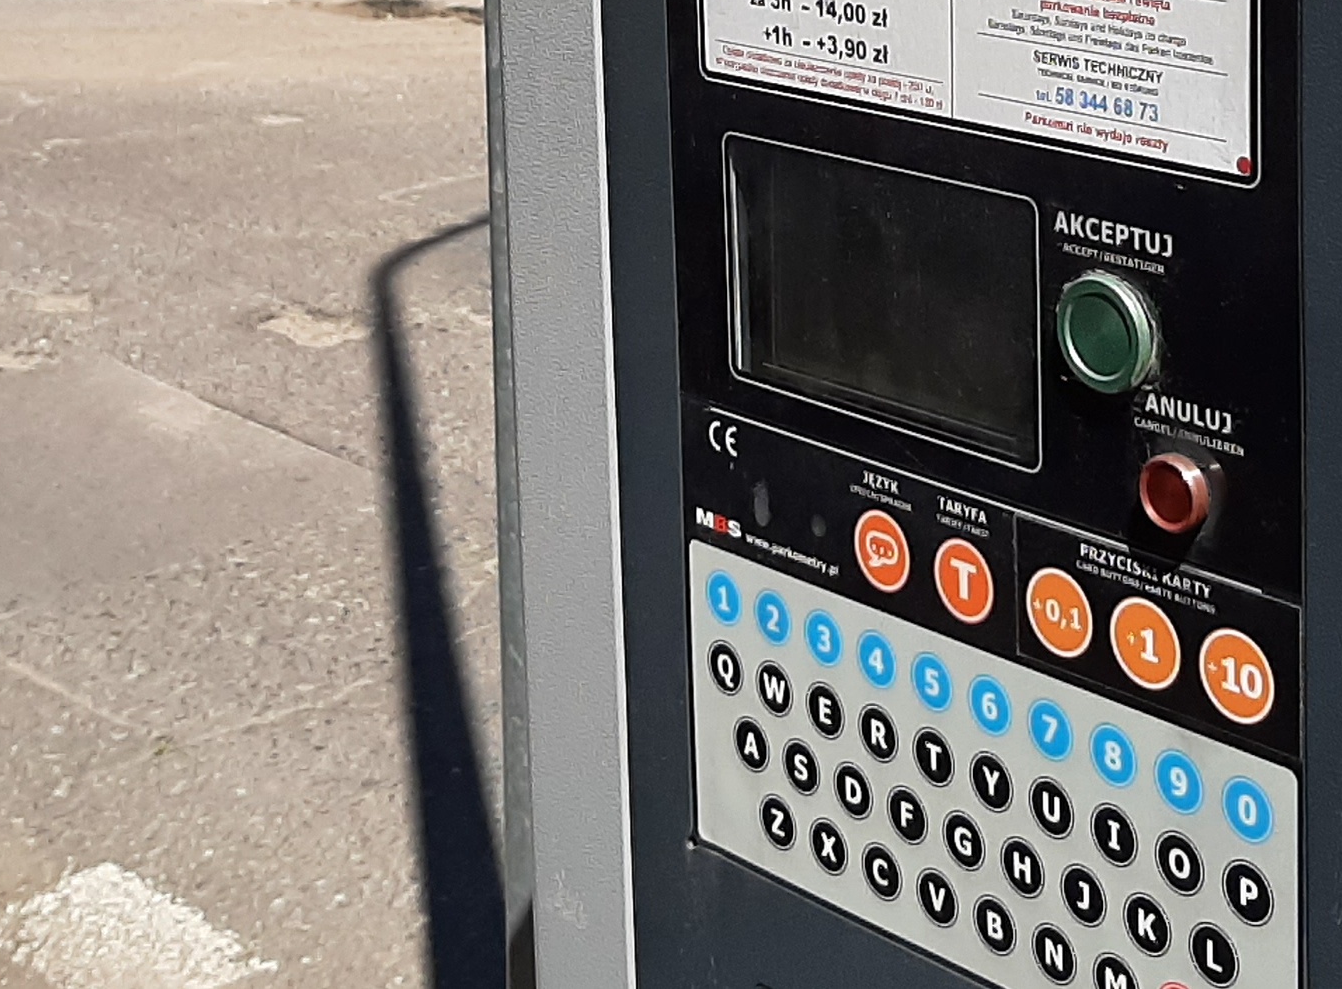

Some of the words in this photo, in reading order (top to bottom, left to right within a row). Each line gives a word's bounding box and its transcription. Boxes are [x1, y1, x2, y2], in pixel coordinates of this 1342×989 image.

[872, 8, 888, 28] zł
[763, 25, 792, 47] +1h
[817, 35, 867, 60] +3,90
[873, 44, 889, 64] zł
[1055, 86, 1075, 106] 58
[1079, 91, 1108, 112] 344
[1113, 97, 1133, 118] 68
[1139, 102, 1158, 122] 73
[1053, 210, 1173, 257] AKCEPTUJ
[1145, 392, 1232, 434] ANULUJ
[862, 470, 899, 494] JĘZYK
[696, 506, 742, 538] MBS
[937, 495, 988, 524] TARYFA
[950, 556, 977, 600] T
[1162, 572, 1212, 599] KARTY
[1207, 656, 1264, 700] +10
[718, 586, 729, 610] 1
[767, 606, 780, 632] 2
[817, 626, 831, 652] 3
[868, 647, 883, 673] 4
[924, 669, 940, 697] 5
[981, 693, 998, 721] 6
[1041, 714, 1057, 743] 7
[1105, 741, 1122, 771] 8
[1170, 767, 1187, 797] 9
[1238, 794, 1256, 826] 0
[717, 654, 734, 688] Q
[763, 675, 785, 702] W
[819, 697, 832, 725] E
[871, 720, 888, 750] R
[924, 741, 942, 771] T
[982, 765, 1000, 797] Y
[1041, 791, 1061, 823] U
[1107, 819, 1121, 851] I
[1168, 847, 1191, 879] O
[1239, 876, 1258, 906] P
[744, 732, 759, 760] A
[794, 754, 809, 782] S
[845, 776, 862, 805] D
[899, 799, 914, 828] F
[953, 829, 972, 858] G
[1012, 851, 1031, 885] H
[1076, 880, 1090, 910] J
[1137, 908, 1156, 941] K
[1206, 938, 1223, 973] L
[771, 809, 785, 838] Z
[821, 831, 836, 863] X
[872, 858, 889, 886] C
[930, 885, 946, 913] V
[987, 914, 1004, 942] B
[1044, 937, 1064, 972] N
[1104, 966, 1127, 989] M
